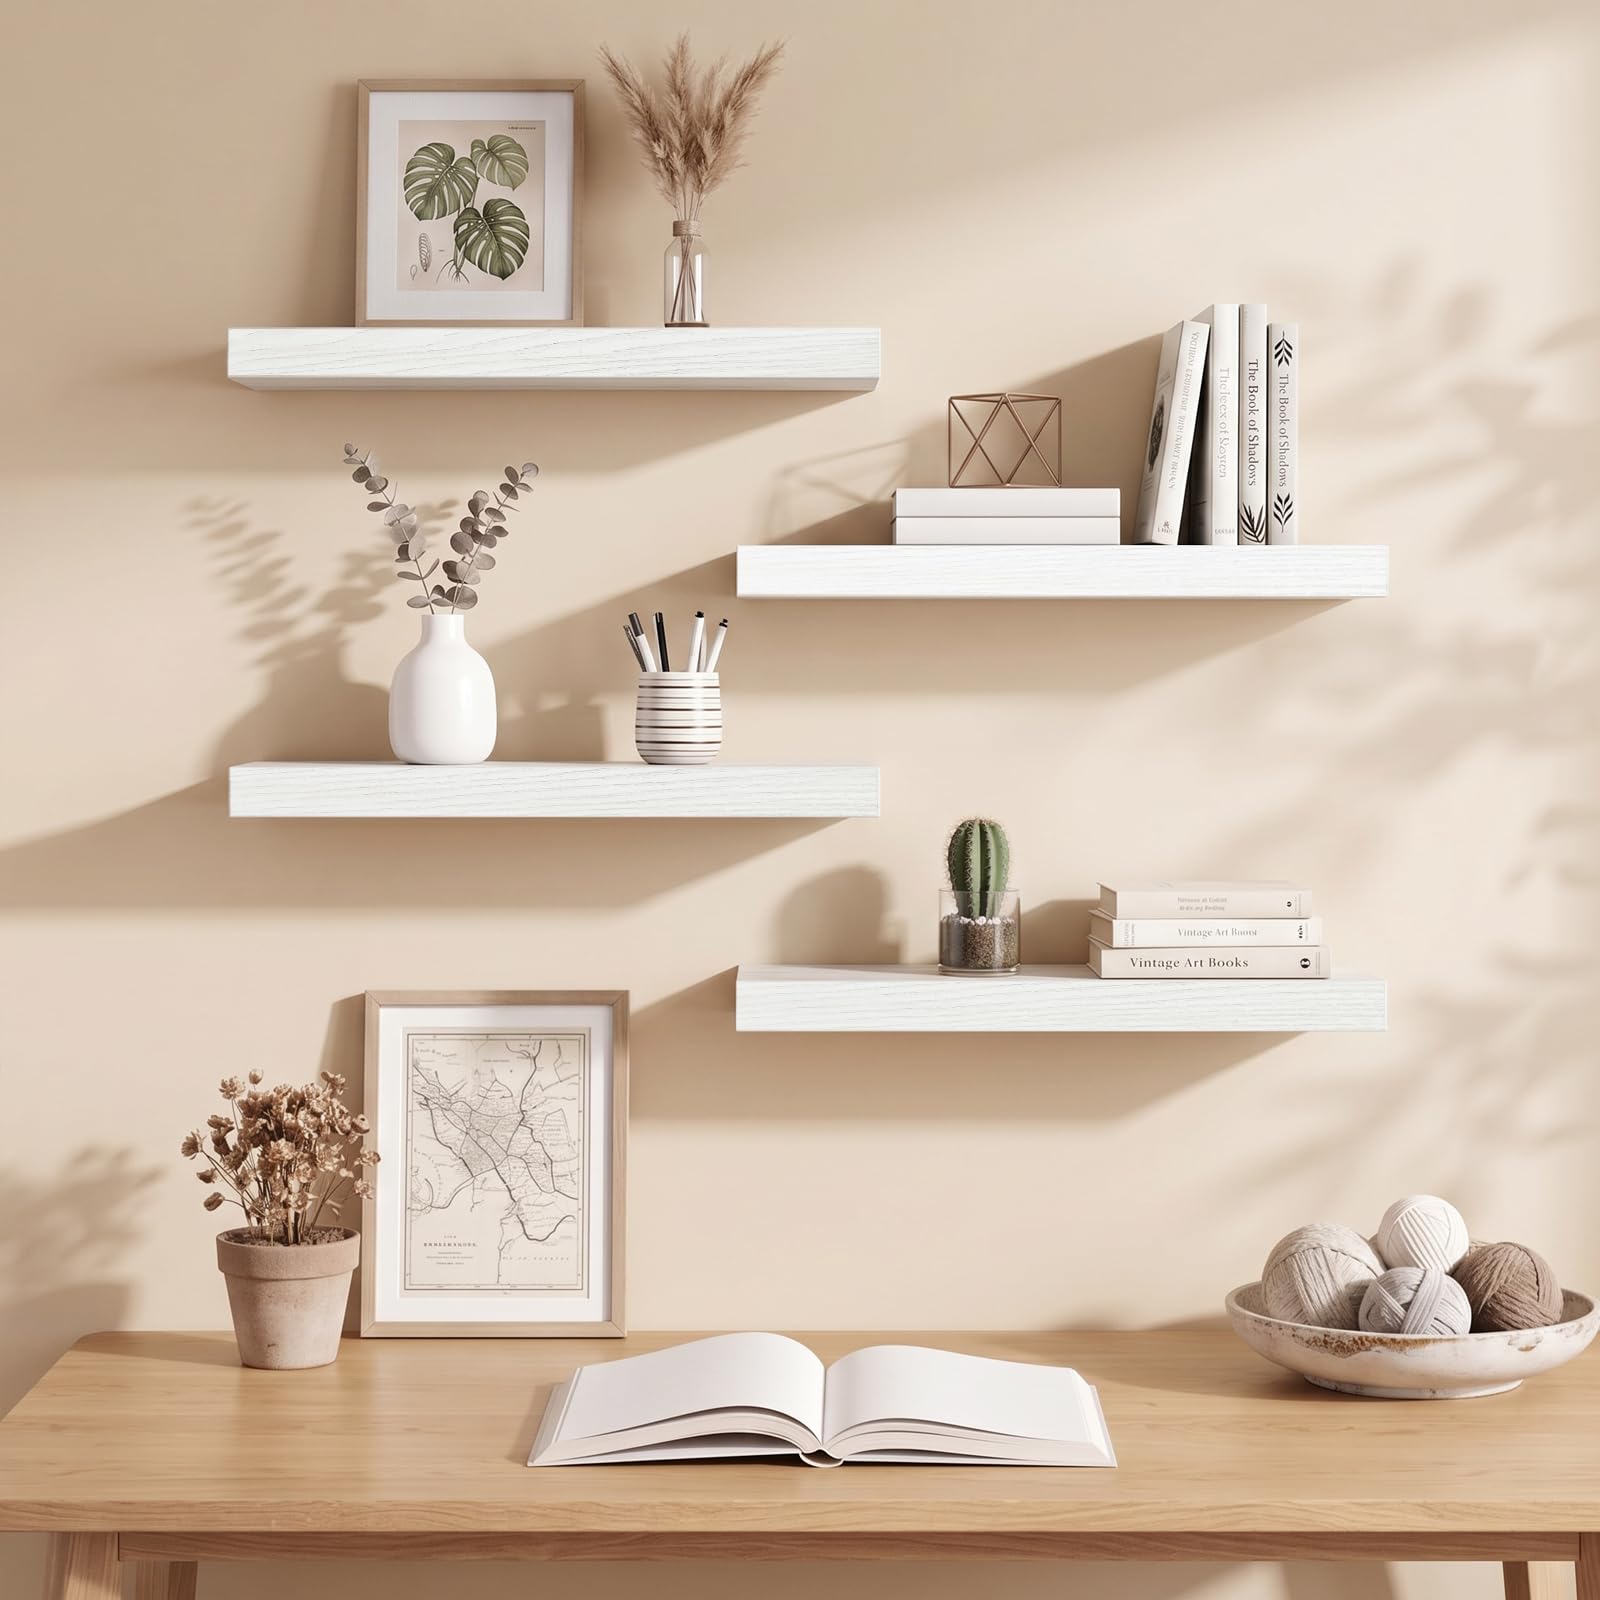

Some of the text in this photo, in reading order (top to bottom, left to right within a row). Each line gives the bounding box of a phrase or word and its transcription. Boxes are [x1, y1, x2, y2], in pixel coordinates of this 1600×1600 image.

[1248, 359, 1259, 486] The Book of Shadows
[1279, 374, 1290, 487] The Book of Shadows
[1130, 957, 1249, 970] Vintage Art Books
[1177, 927, 1213, 938] Vintage
[1215, 927, 1229, 936] Art
